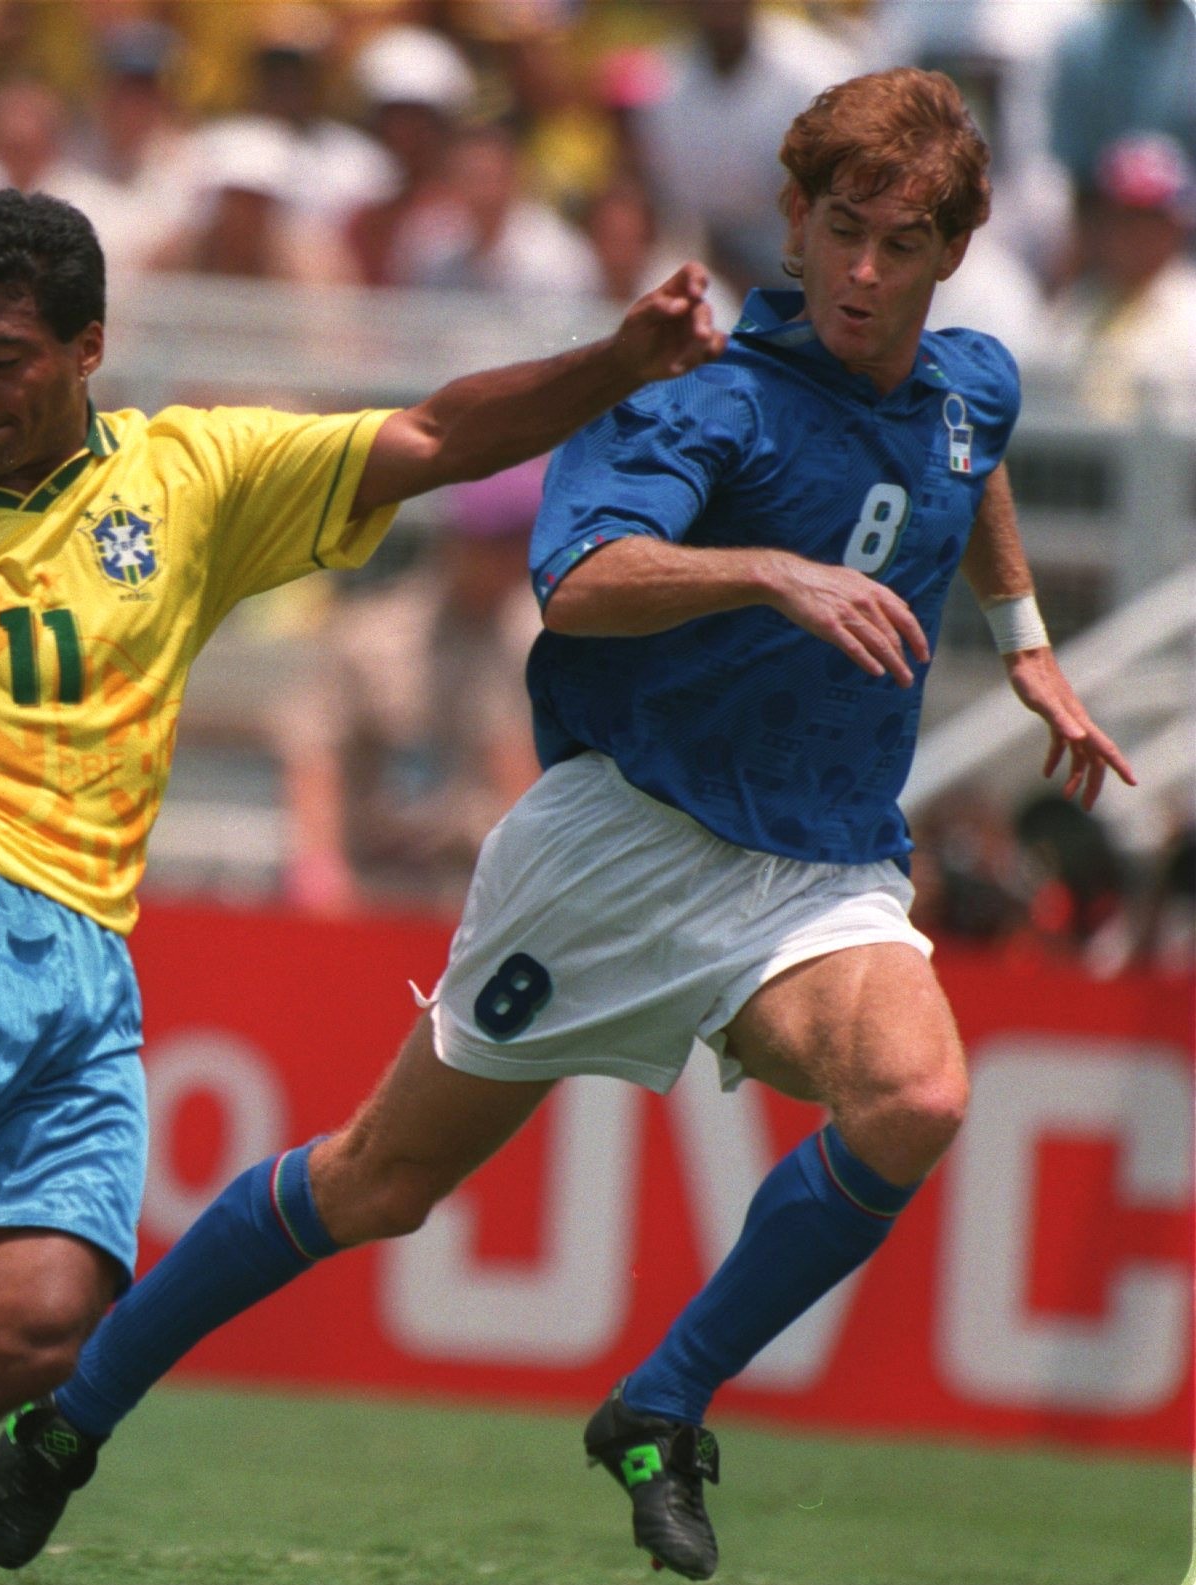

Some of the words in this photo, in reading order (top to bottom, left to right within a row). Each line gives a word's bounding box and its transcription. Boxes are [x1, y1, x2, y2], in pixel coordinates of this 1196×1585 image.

[842, 483, 910, 576] 8
[474, 951, 553, 1043] 8
[377, 1034, 1194, 1417] JVC
